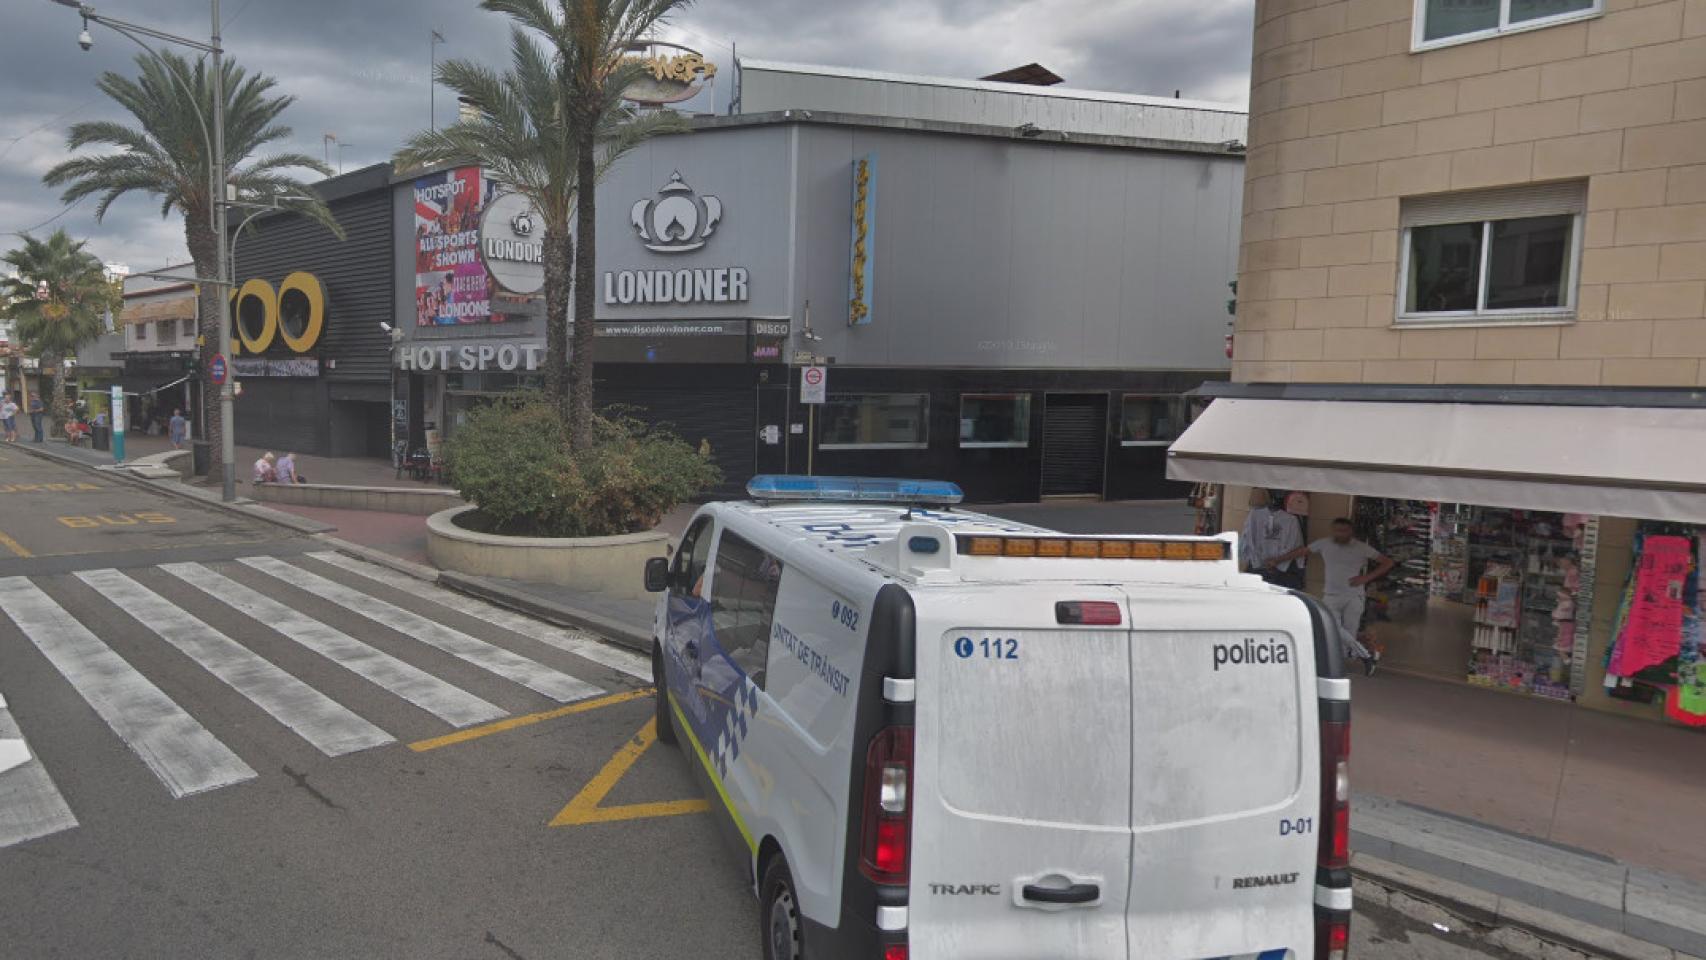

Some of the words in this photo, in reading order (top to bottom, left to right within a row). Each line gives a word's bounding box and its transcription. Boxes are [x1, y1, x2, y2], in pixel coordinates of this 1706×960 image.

[436, 229, 477, 250] SPORTS
[436, 248, 476, 266] SHOWN
[605, 267, 747, 304] LONDONER
[756, 323, 788, 334] DISCO
[399, 345, 450, 371] HOT
[459, 343, 540, 371] SPOT
[57, 512, 177, 529] BUS
[841, 606, 859, 631] 092
[798, 640, 810, 665] DE
[979, 637, 1019, 659] 112
[1213, 637, 1290, 671] policia
[1280, 817, 1312, 836] D-01
[928, 883, 1001, 895] TRAFIC
[1232, 872, 1300, 889] RENAULT
